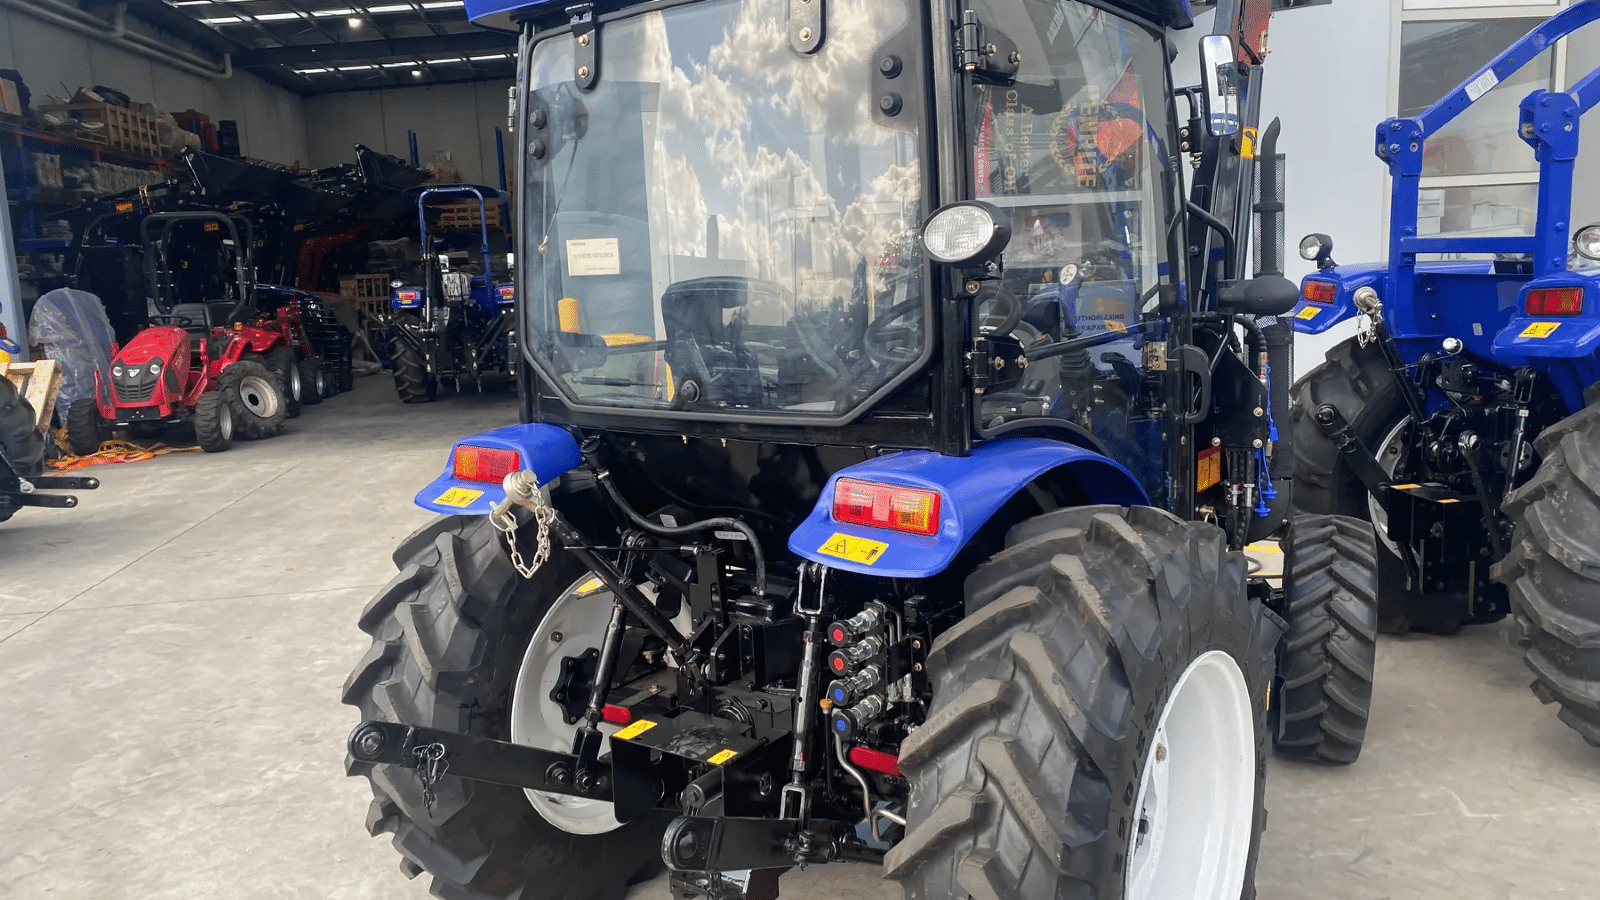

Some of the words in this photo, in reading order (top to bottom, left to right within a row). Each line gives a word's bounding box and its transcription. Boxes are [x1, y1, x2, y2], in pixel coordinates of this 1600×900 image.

[1005, 89, 1018, 136] Class
[1021, 104, 1034, 117] A
[1004, 142, 1017, 159] of
[1020, 123, 1033, 177] Better
[1004, 166, 1016, 193] Oil
